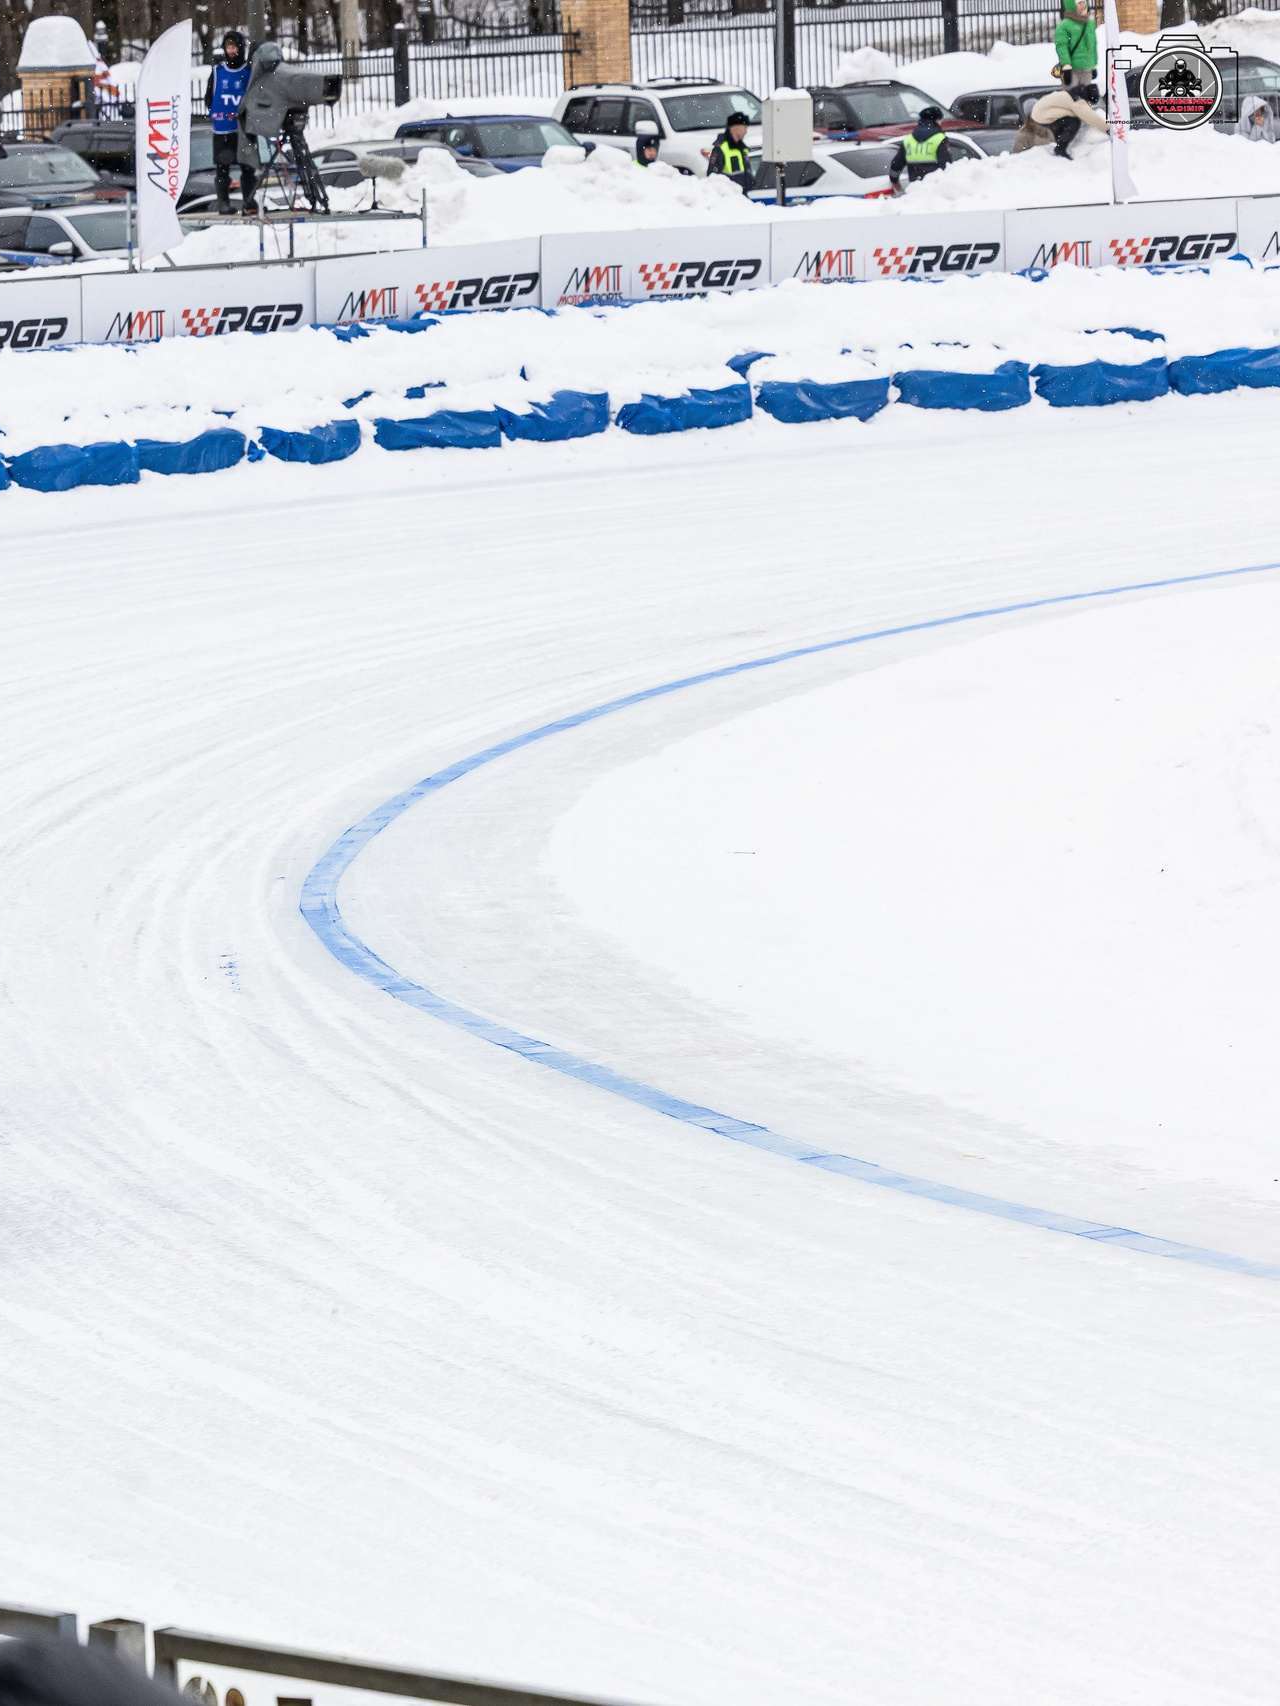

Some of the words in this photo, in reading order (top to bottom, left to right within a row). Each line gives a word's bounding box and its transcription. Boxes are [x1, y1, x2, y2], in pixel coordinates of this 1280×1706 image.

[221, 94, 241, 105] TV
[908, 242, 1001, 273] RGP
[1144, 233, 1238, 263] RGP
[671, 259, 762, 290] RGP
[448, 272, 540, 309] RGP
[214, 304, 303, 335] RGP
